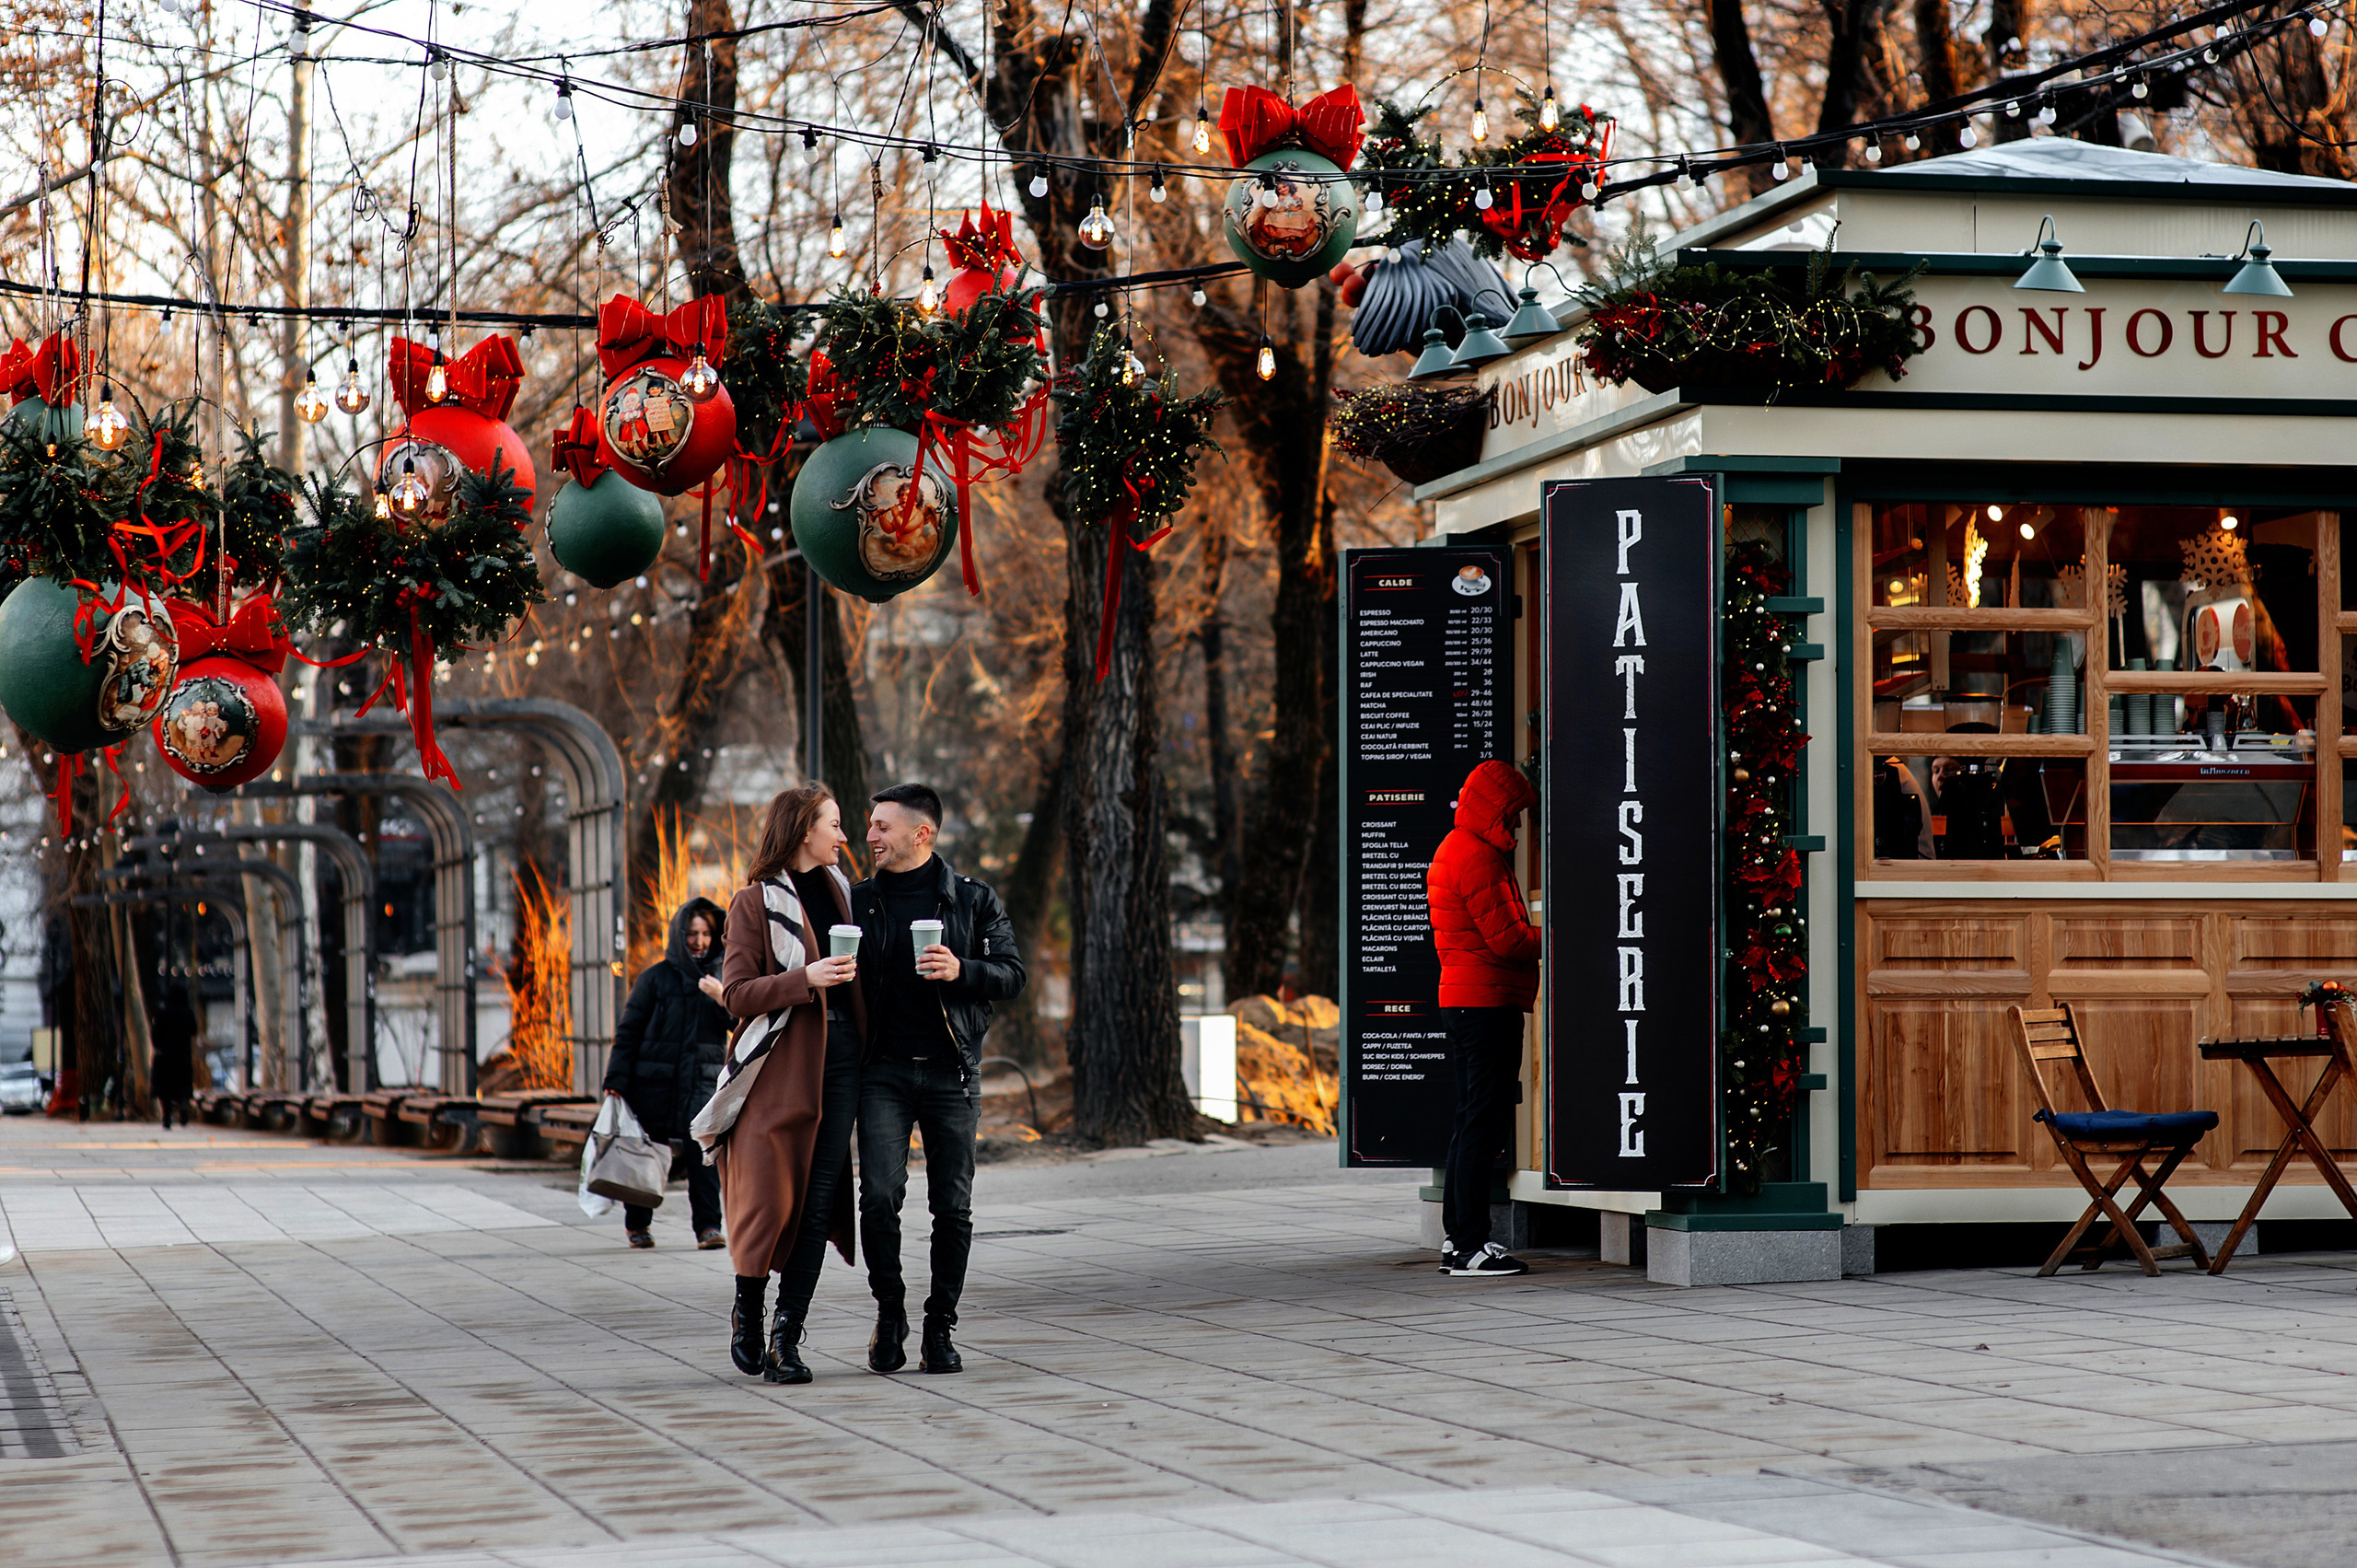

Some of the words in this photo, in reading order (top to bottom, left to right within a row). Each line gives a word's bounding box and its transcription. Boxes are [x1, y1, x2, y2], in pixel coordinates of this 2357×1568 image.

[1490, 352, 1586, 430] BONJOUR
[1378, 578, 1412, 587] CALDE
[1470, 606, 1493, 614] 20/30
[1470, 616, 1492, 624] 22/33
[1470, 626, 1493, 634] 20/30
[1470, 637, 1492, 645] 25/36
[1470, 647, 1492, 656] 29/39
[1470, 657, 1492, 666] 34/44
[1470, 699, 1493, 707] 48/68
[1471, 709, 1493, 718] 26/28
[1472, 720, 1493, 728] 15/24
[1483, 730, 1493, 738] 28
[1483, 740, 1493, 749] 26
[1480, 750, 1493, 759] 3/5
[1612, 509, 1647, 1158] PATISERIE
[1384, 1005, 1411, 1013] RECE
